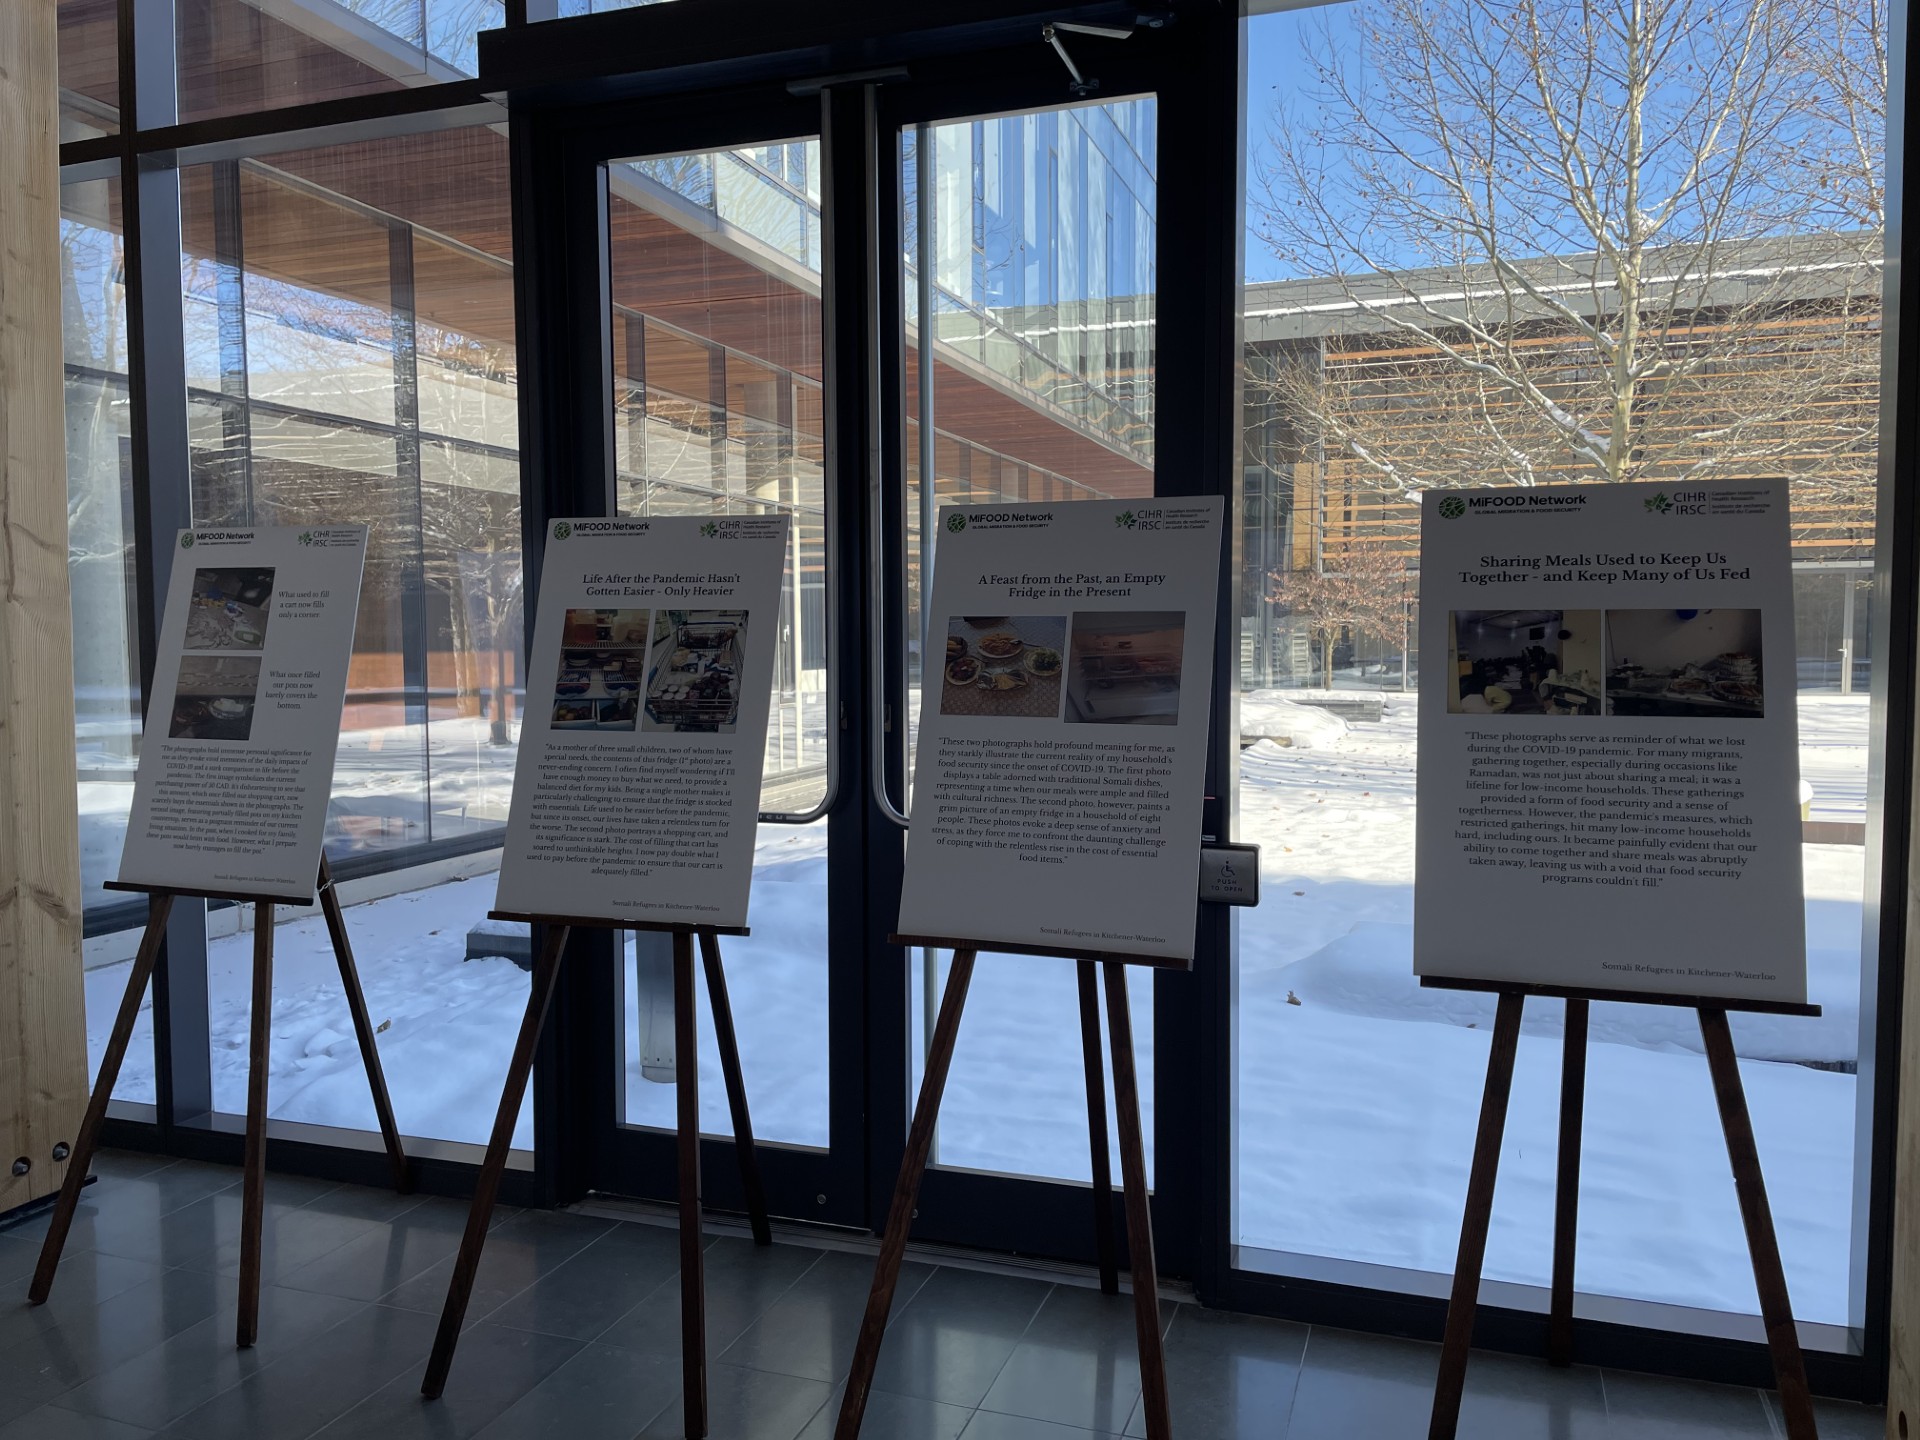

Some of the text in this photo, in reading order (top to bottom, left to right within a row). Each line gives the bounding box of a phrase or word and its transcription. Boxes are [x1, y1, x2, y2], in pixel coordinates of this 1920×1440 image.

[1469, 494, 1586, 507] MiFOOD Network
[1674, 492, 1706, 502] CIHR
[1138, 510, 1162, 518] CIHR
[1676, 504, 1706, 514] IRSC
[969, 512, 1053, 522] MiFOOD Network
[574, 522, 650, 531] MiFOOD Network
[719, 520, 740, 529] CIHR
[1138, 521, 1161, 530] IRSC
[720, 531, 739, 539] IRSC
[1480, 551, 1726, 570] Sharing Meals Used to Keep Us
[583, 573, 740, 583] Life After the Pandemic Hasn't
[979, 574, 987, 584] A
[990, 574, 1018, 584] Feast
[1021, 573, 1051, 584] from
[1054, 573, 1073, 583] the
[1076, 573, 1102, 585] Past,
[1124, 573, 1165, 586] Empty
[1459, 569, 1528, 586] Together
[1543, 568, 1572, 581] and
[1578, 568, 1617, 584] Keep
[1622, 567, 1669, 584] Many
[1673, 567, 1692, 580] of
[1695, 567, 1715, 580] Us
[1720, 566, 1750, 579] Fed
[586, 585, 620, 595] Gotten
[623, 585, 655, 595] Easier
[664, 585, 691, 598] Only
[693, 585, 733, 595] Heavier
[1009, 586, 1131, 600] Fridge in the Present
[939, 736, 966, 746] "These
[982, 738, 1032, 750] photographs
[1033, 739, 1053, 748] hold
[1054, 740, 1094, 752] profound
[1095, 741, 1132, 753] meaning
[1133, 742, 1146, 751] for
[1465, 731, 1499, 741] "These
[1502, 731, 1566, 744] photographs
[1612, 733, 1662, 744] reminder
[1665, 734, 1677, 744] of
[1679, 734, 1705, 745] what
[1726, 735, 1745, 745] lost
[939, 747, 1172, 764] they starkly illustrate the current reality of my household's
[1467, 743, 1742, 761] during the COVID-19 pandemic. For many migrants,
[1472, 755, 1737, 772] gathering together, especially during occasions like
[1466, 780, 1744, 800] lifeline for low-income households. These gatherings
[1460, 817, 1751, 838] restricted gatherings, hit many low-income households
[1602, 962, 1632, 971] Somali
[1635, 964, 1674, 975] Refugees
[1688, 968, 1776, 981] Kitchener-Waterloo
